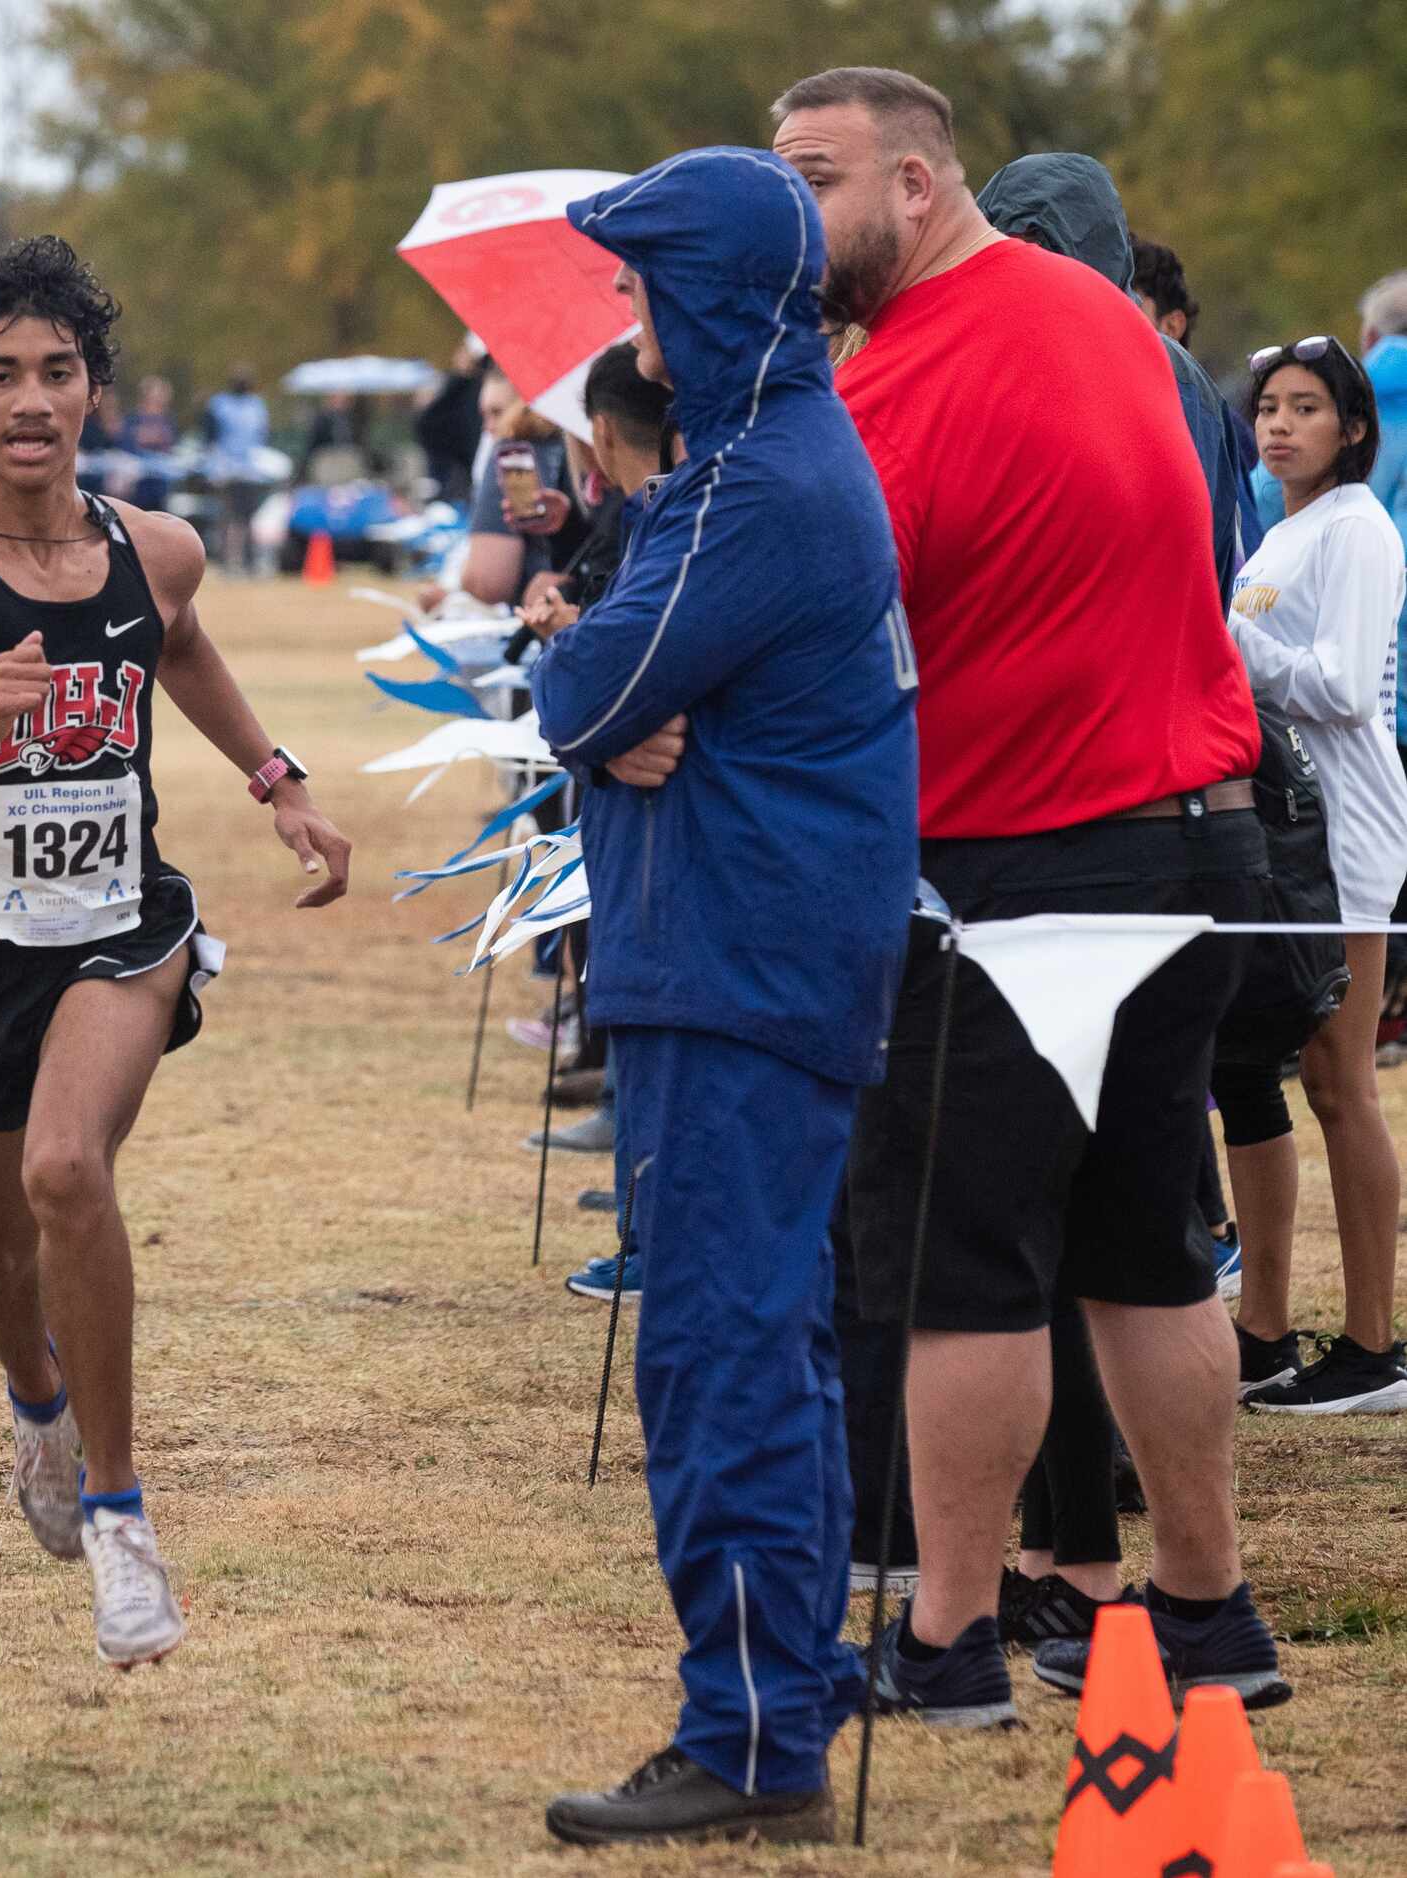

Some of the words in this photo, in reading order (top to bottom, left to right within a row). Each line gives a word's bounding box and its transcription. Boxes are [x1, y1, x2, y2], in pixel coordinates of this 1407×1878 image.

[24, 788, 47, 800] UIL
[52, 786, 101, 799] Region
[105, 785, 114, 796] II
[8, 804, 27, 816] XC
[32, 798, 126, 815] Championship
[3, 813, 128, 879] 1324
